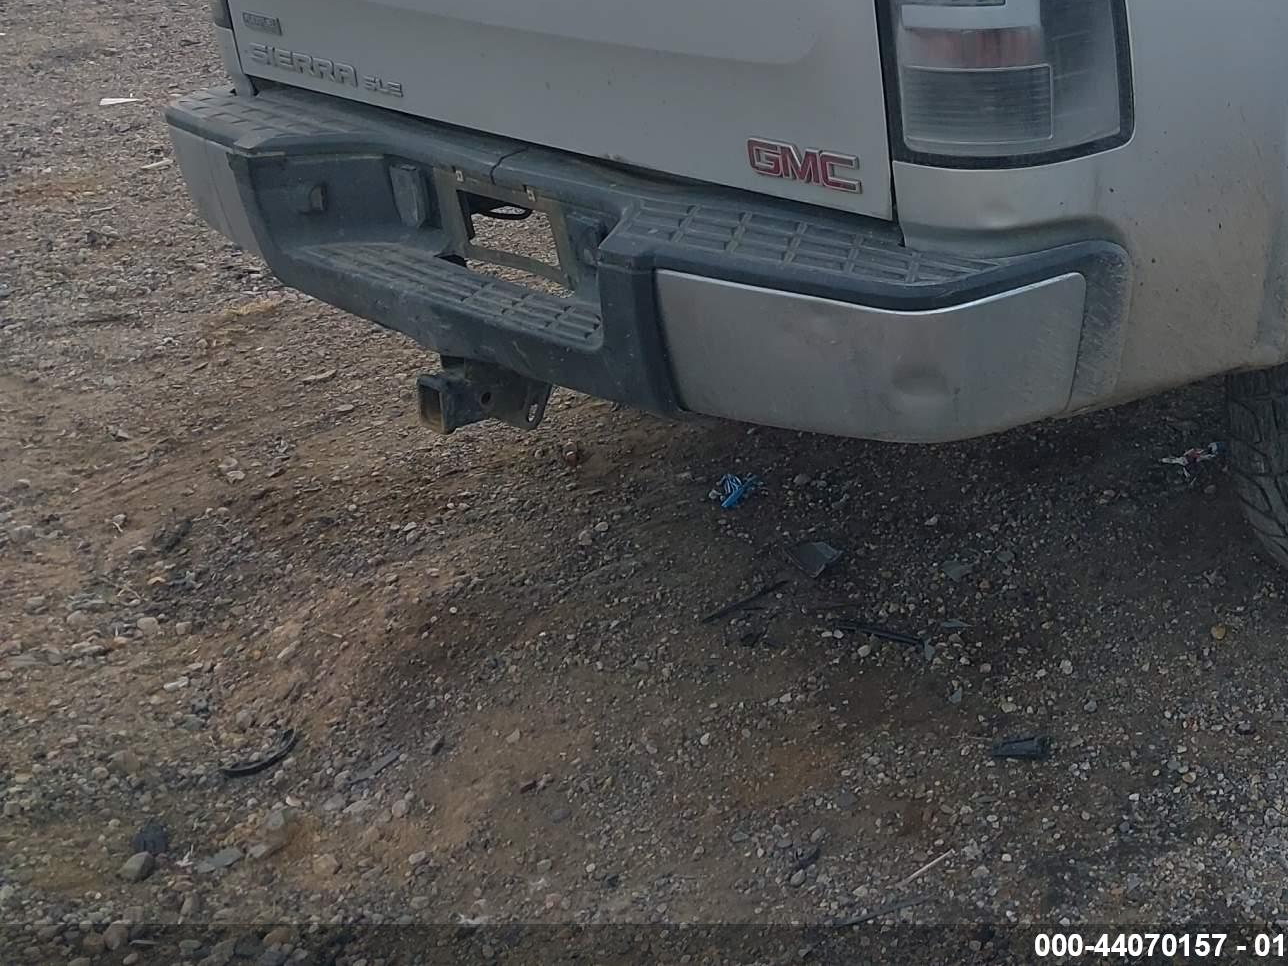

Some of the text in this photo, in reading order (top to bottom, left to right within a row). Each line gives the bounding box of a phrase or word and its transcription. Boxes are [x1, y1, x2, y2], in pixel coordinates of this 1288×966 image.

[248, 42, 359, 88] SIERRA
[362, 75, 404, 98] SLE
[747, 137, 863, 194] GMC
